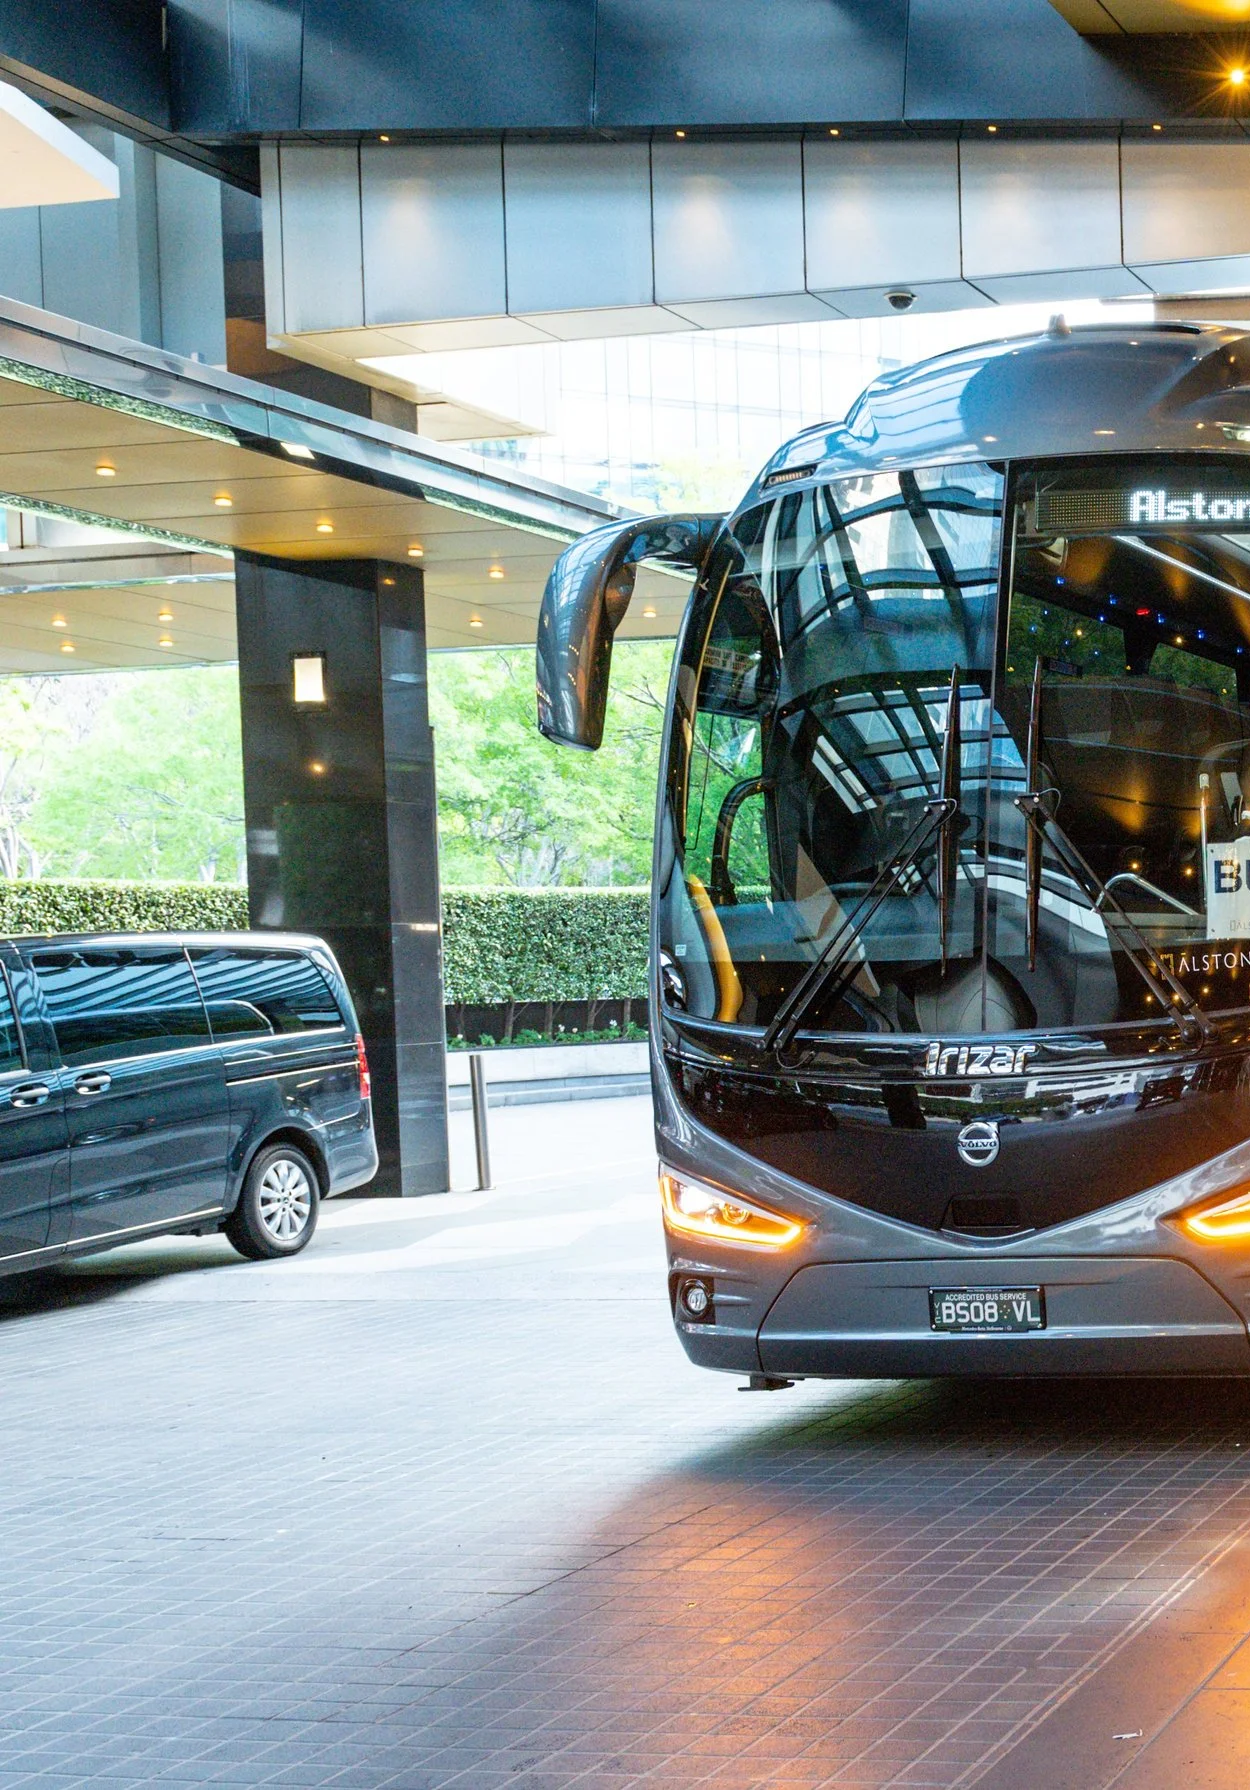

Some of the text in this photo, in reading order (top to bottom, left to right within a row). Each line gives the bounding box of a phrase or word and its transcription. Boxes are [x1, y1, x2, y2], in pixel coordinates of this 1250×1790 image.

[960, 1140, 997, 1148] VOLVO
[945, 1292, 1026, 1301] ACCREDITED BUS SERVICE
[1012, 1300, 1041, 1322] VL
